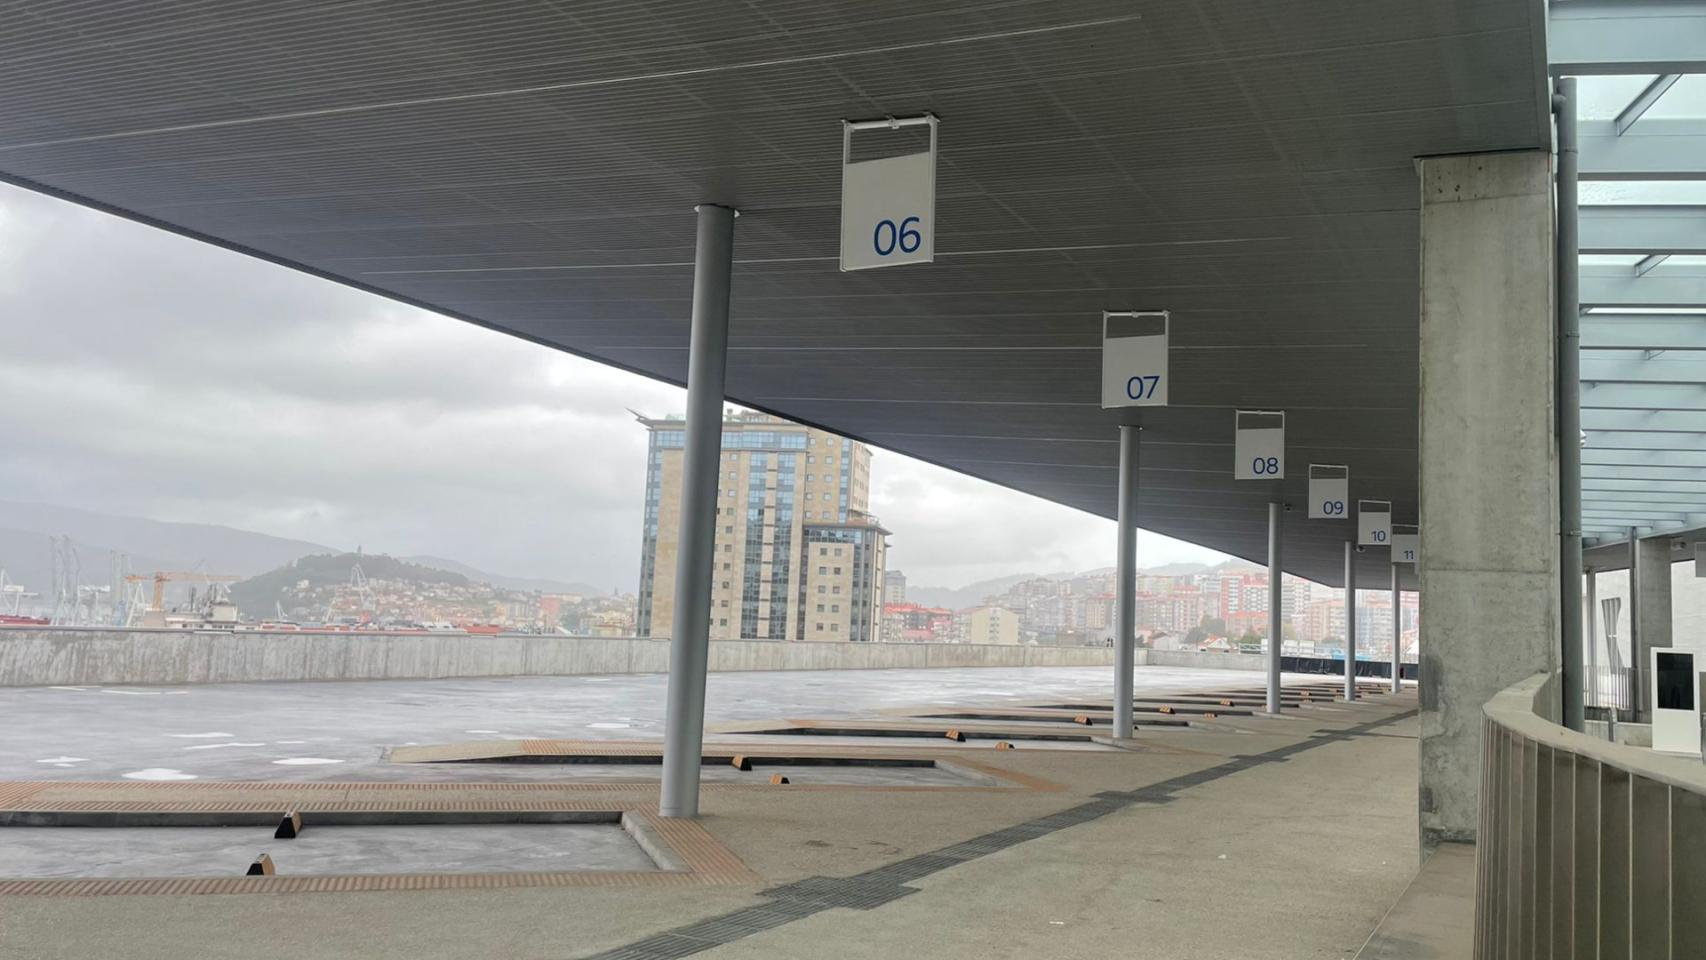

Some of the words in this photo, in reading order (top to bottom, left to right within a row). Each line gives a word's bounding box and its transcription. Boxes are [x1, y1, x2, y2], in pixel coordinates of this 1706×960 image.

[873, 216, 921, 256] 06
[1126, 375, 1160, 400] 07
[1253, 457, 1279, 475] 08
[1323, 501, 1344, 515] 09
[1371, 530, 1386, 542] 10
[1403, 550, 1414, 560] 11
